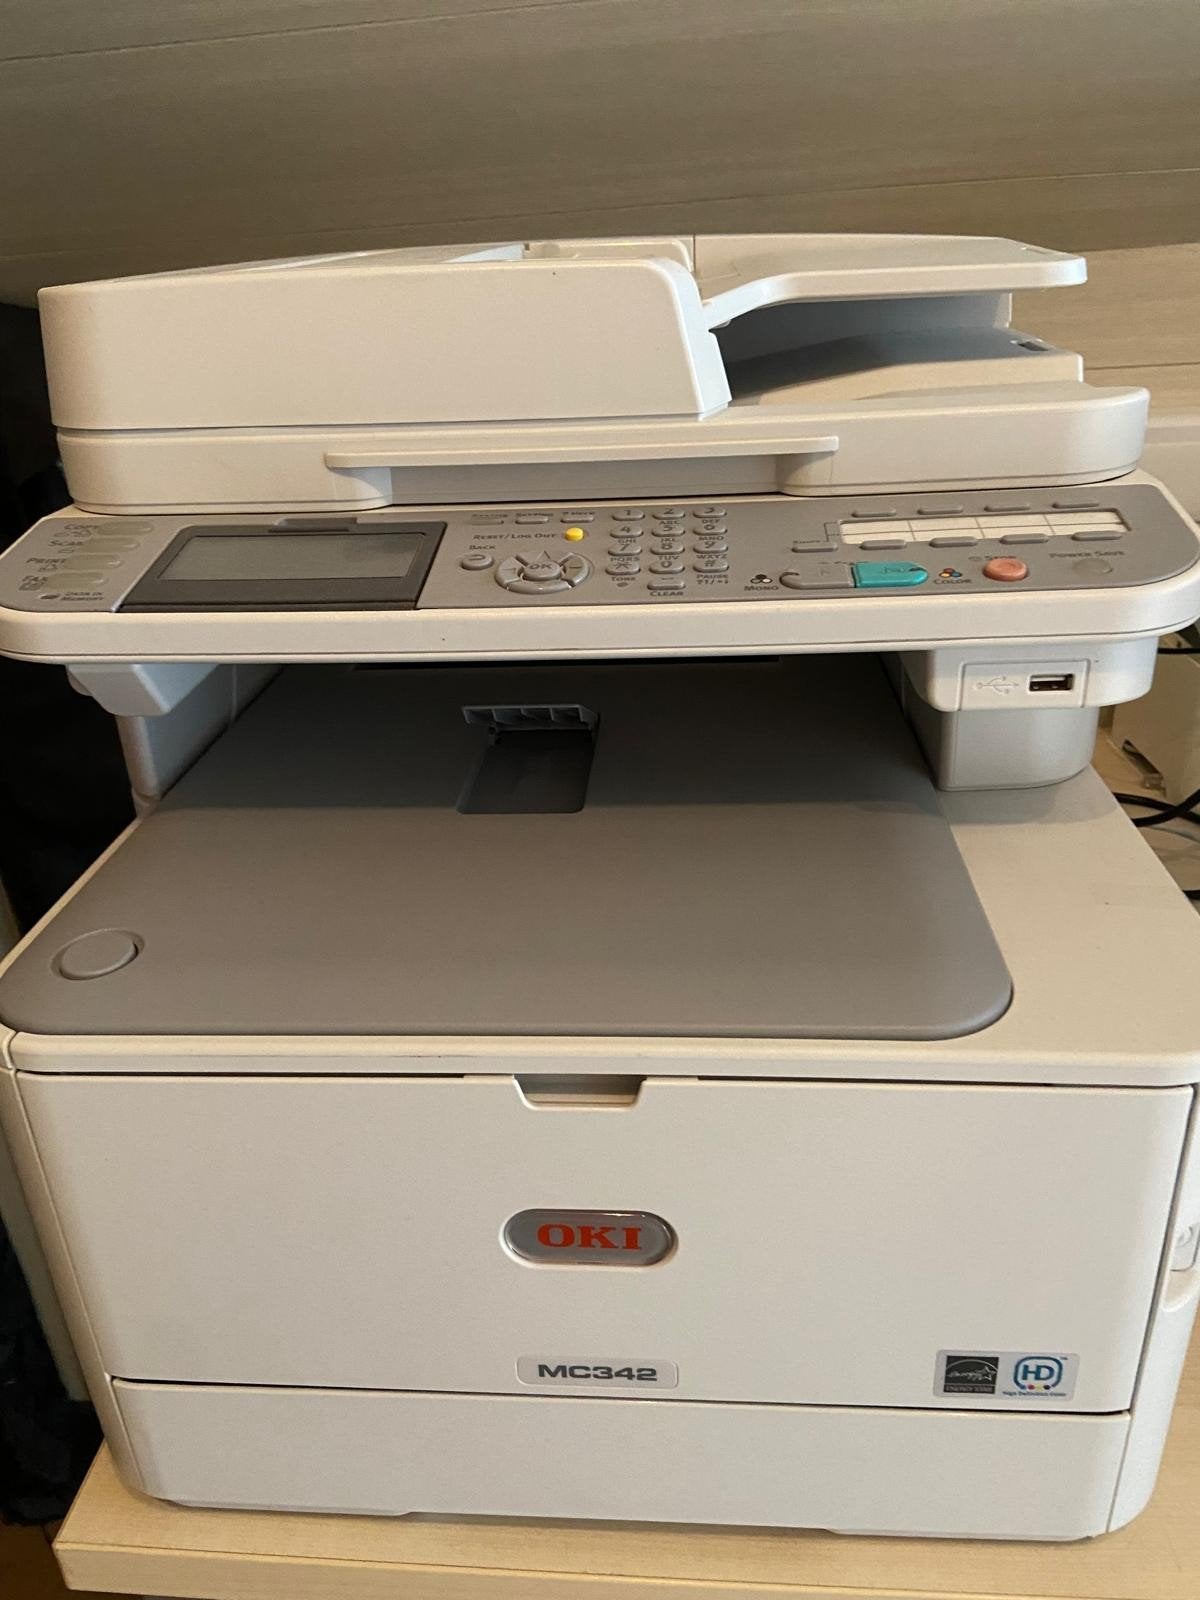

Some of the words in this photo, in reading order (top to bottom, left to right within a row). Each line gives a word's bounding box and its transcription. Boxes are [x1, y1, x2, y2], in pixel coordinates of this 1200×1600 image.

[620, 526, 632, 534] 4
[620, 543, 630, 551] 7
[529, 562, 553, 570] OK
[536, 1222, 642, 1250] OKI
[538, 1364, 658, 1382] MC342
[1021, 1364, 1056, 1381] HD
